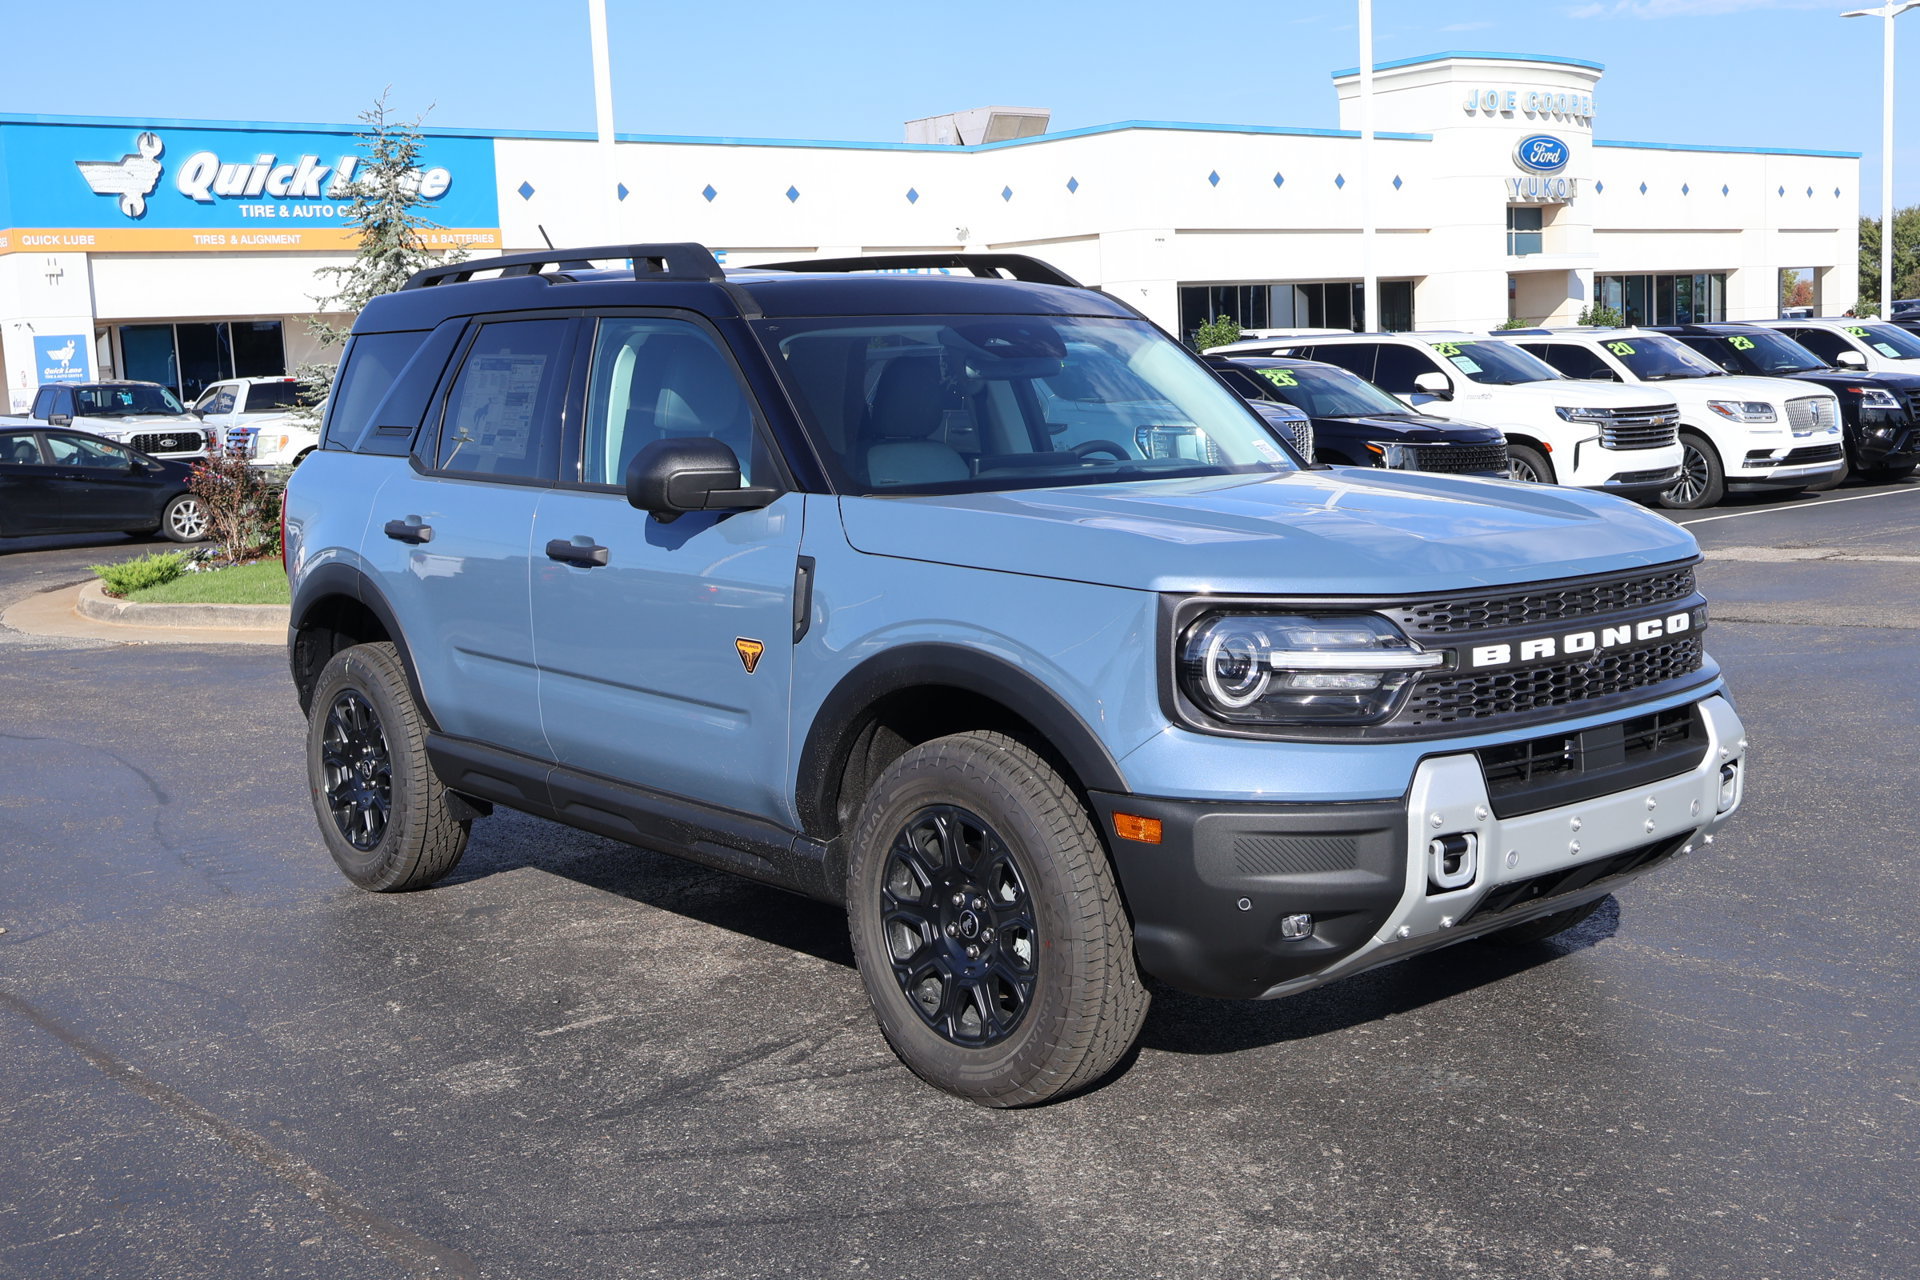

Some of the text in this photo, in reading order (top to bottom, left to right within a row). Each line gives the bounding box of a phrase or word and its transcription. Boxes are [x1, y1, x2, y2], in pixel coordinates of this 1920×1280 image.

[1465, 88, 1516, 110] JOE
[1530, 141, 1561, 163] Ford
[176, 150, 332, 202] Quick
[239, 204, 276, 218] TIRE
[279, 204, 290, 218] &
[292, 204, 334, 218] AUTO
[21, 234, 61, 246] QUICK
[63, 234, 96, 245] LUBE
[193, 234, 302, 245] TIRES & ALIGNMENT
[431, 234, 439, 244] &
[441, 234, 495, 244] BATTERIES
[1607, 341, 1636, 356] 20
[1728, 335, 1755, 351] 23
[43, 367, 64, 375] Quick
[1264, 372, 1298, 387] 26
[1472, 611, 1691, 668] BRONCO
